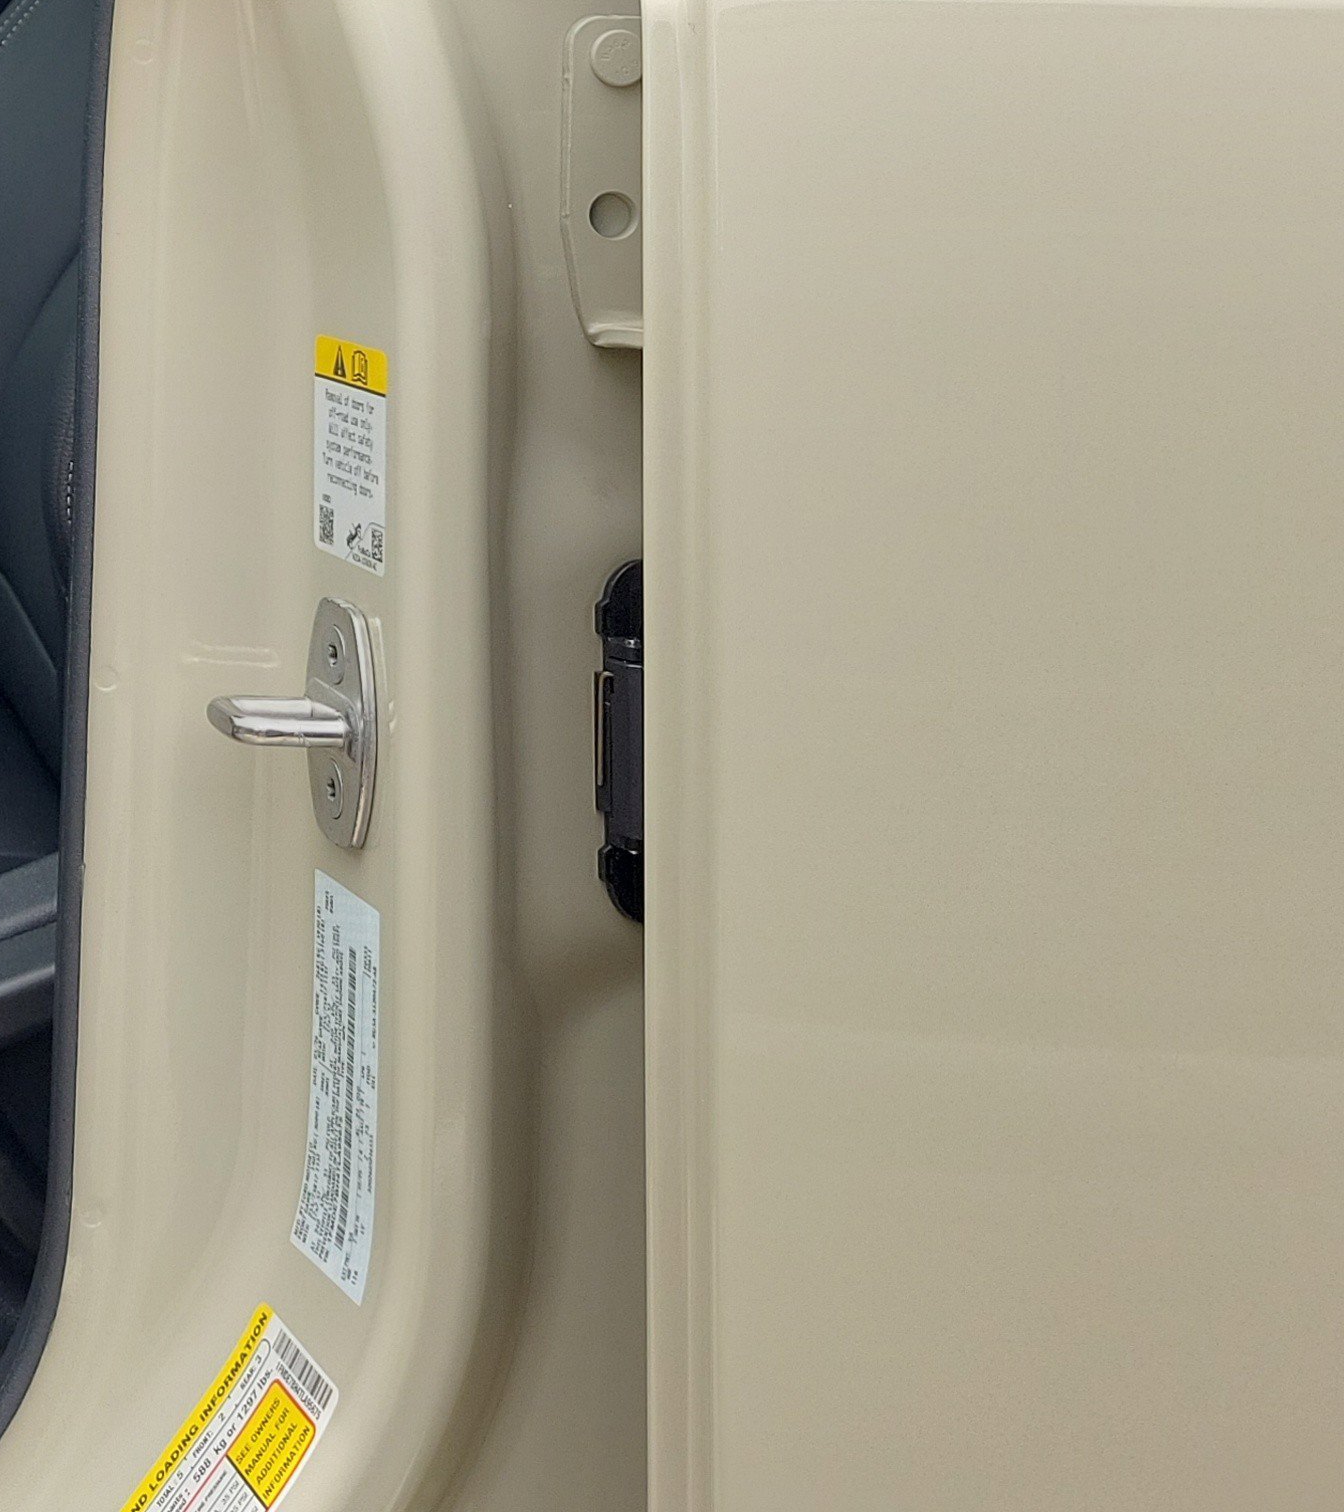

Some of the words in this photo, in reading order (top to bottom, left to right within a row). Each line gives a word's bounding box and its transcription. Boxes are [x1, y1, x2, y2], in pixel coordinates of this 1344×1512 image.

[255, 1354, 263, 1364] 3
[131, 1493, 148, 1512] ND
[148, 1424, 199, 1492] LOADING
[199, 1312, 268, 1422] INFORMATION
[193, 1458, 211, 1483] 588
[214, 1439, 228, 1455] kg
[226, 1423, 237, 1438] or
[236, 1389, 258, 1421] 1297
[257, 1368, 273, 1390] lbs.
[218, 1412, 226, 1422] 2
[235, 1443, 252, 1464] SEE
[250, 1397, 281, 1443] OWNERS
[244, 1433, 277, 1476] MANUAL
[274, 1407, 290, 1430] FOR
[176, 1471, 184, 1480] 5
[256, 1423, 298, 1485] ADDITIONAL
[262, 1425, 311, 1500] INFORMATION
